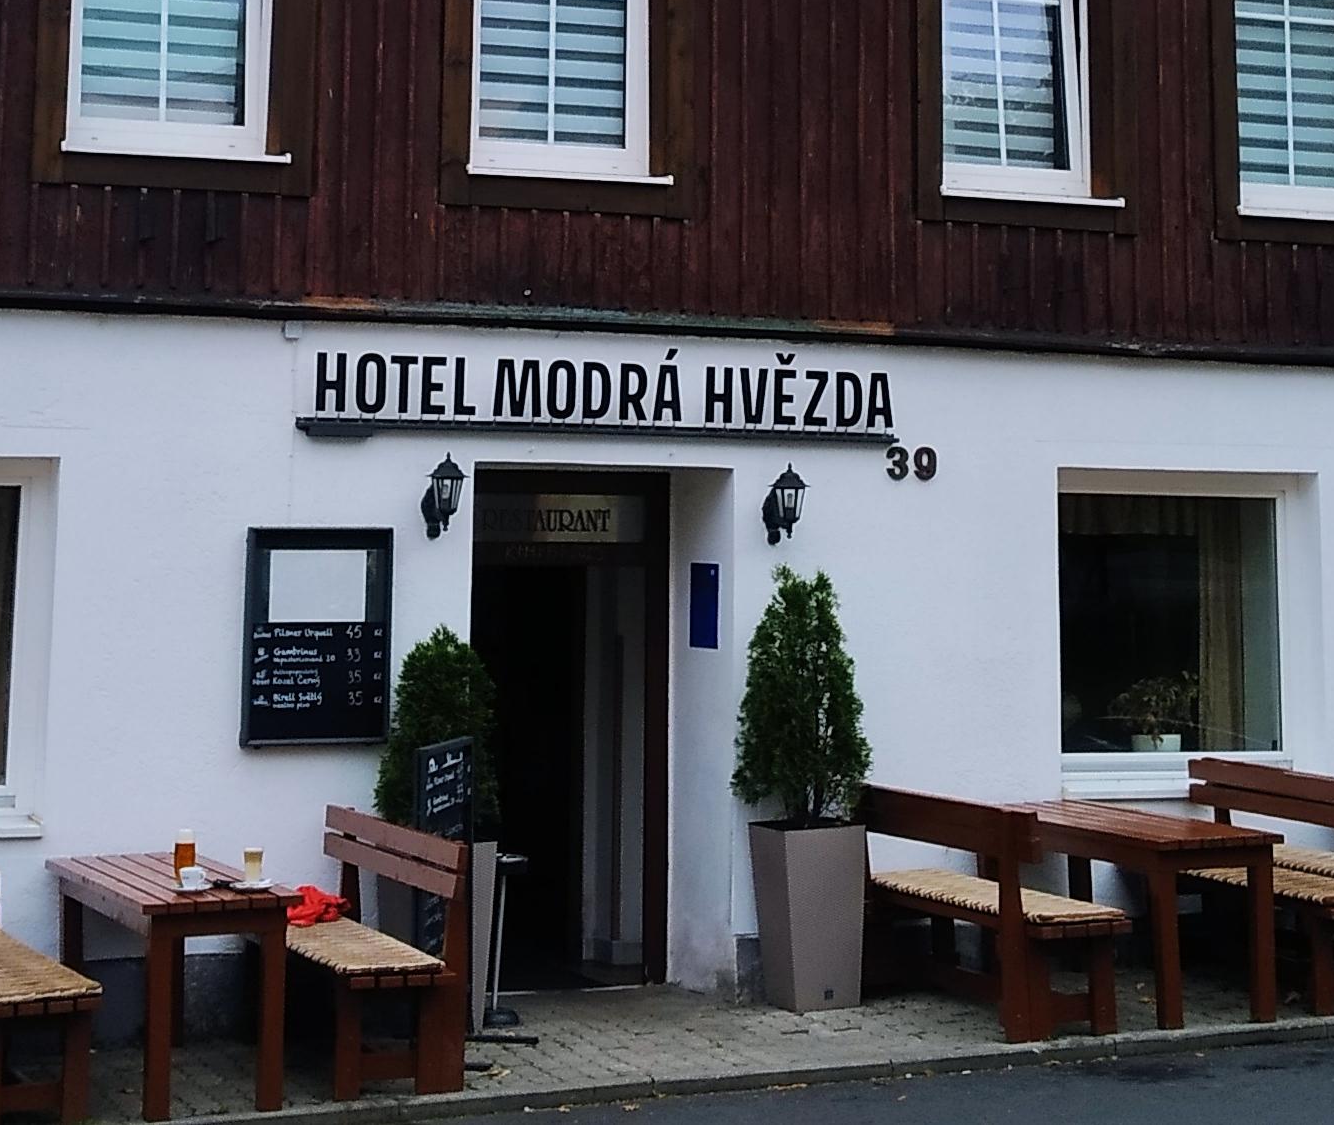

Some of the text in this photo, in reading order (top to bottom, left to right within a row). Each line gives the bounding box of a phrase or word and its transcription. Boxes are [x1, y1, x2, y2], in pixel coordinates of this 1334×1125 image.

[315, 348, 893, 429] HOTEL MODRÁ HVĚZDA
[885, 446, 938, 481] 39
[482, 507, 611, 532] RESTAURANT
[345, 624, 363, 640] 45
[273, 645, 318, 656] Gambrinus
[346, 647, 362, 663] 33
[347, 669, 363, 684] 35
[347, 690, 364, 706] 35
